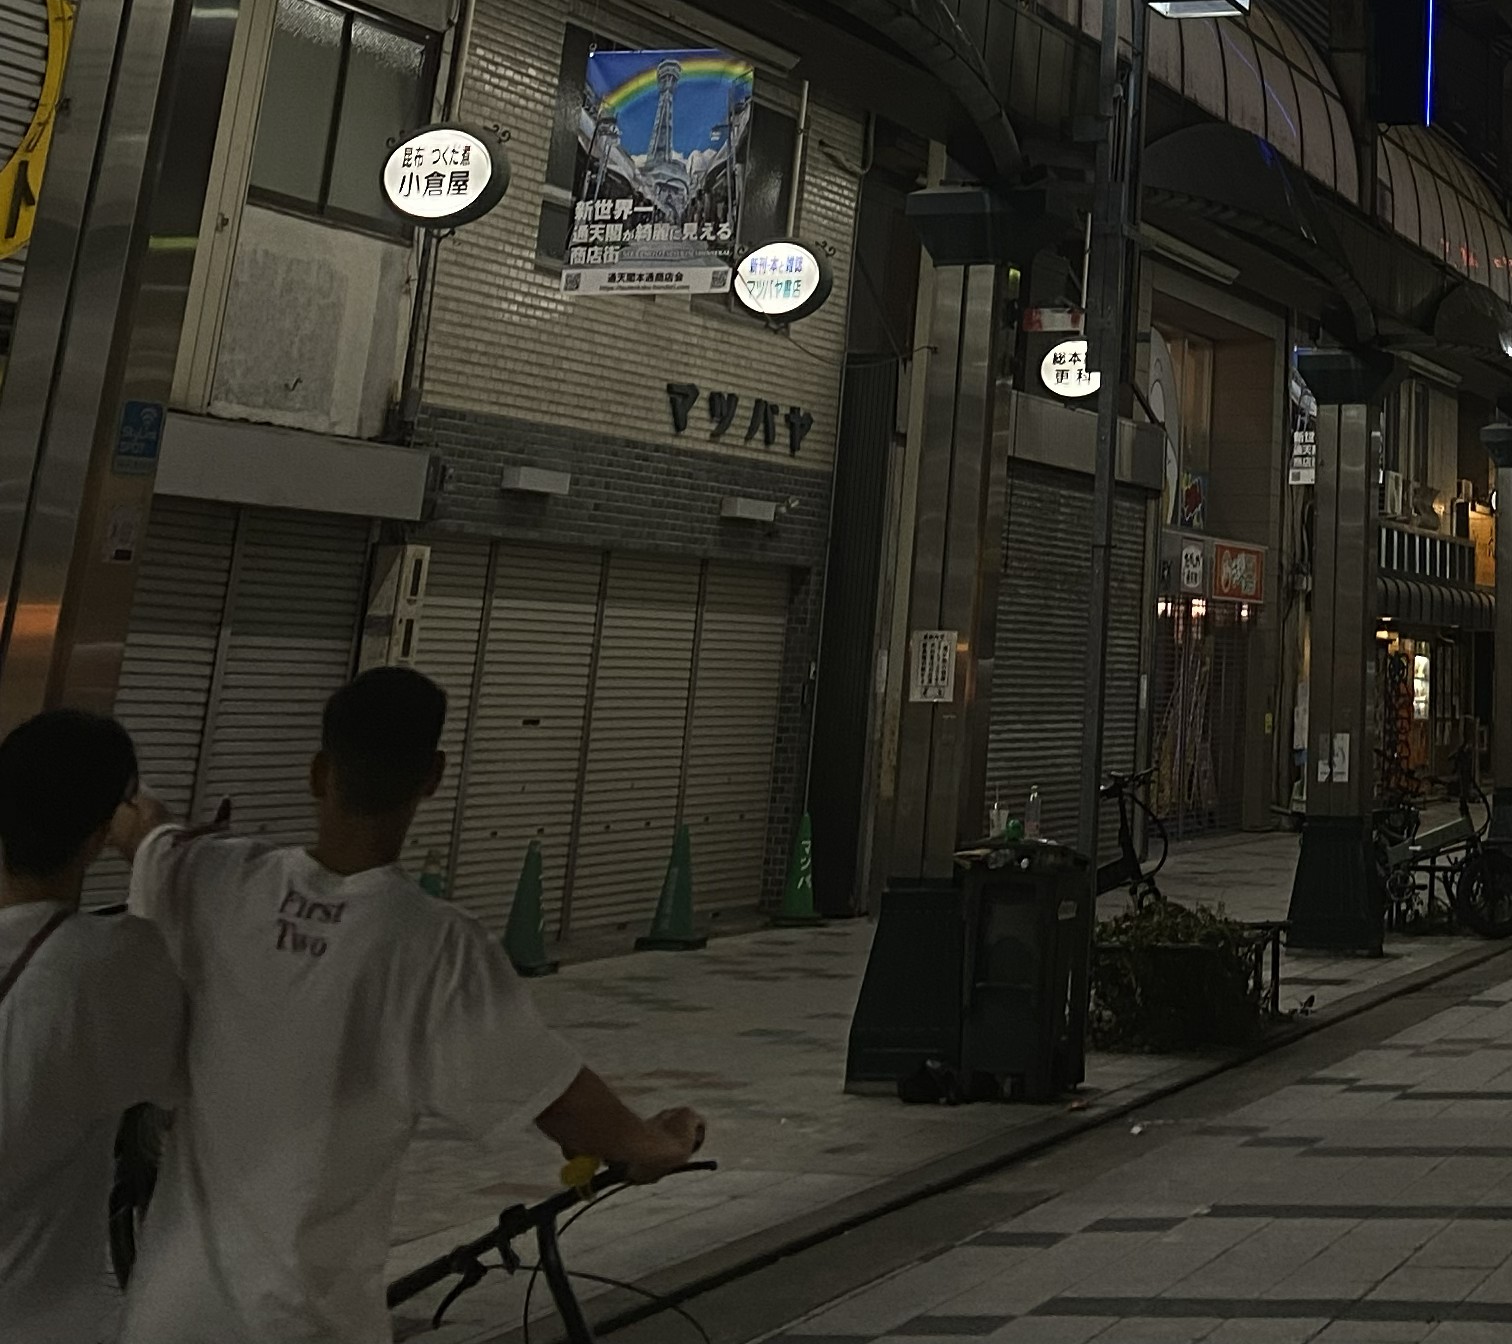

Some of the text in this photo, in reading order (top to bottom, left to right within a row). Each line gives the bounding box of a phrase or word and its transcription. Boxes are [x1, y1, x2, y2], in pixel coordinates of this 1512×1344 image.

[402, 146, 425, 168] 昆布
[398, 170, 470, 197] 小倉屋
[574, 198, 655, 221] 新世界一
[571, 222, 733, 244] 通天閣が綺麗に見える
[569, 244, 620, 266] 商店街
[1052, 351, 1087, 366] 総本
[665, 381, 815, 455] マツバヤ
[279, 889, 347, 924] First
[276, 917, 329, 957] Two
